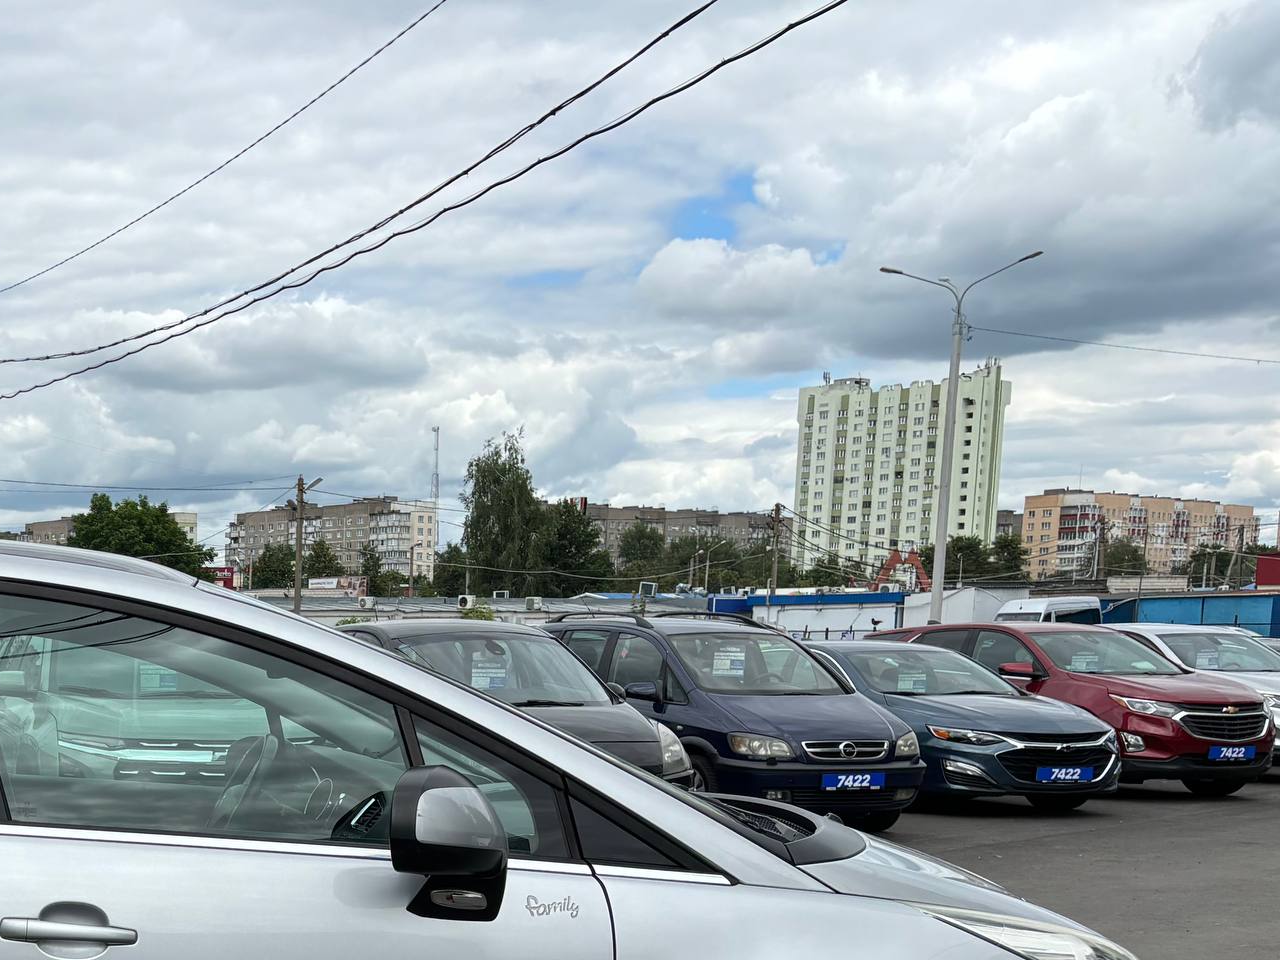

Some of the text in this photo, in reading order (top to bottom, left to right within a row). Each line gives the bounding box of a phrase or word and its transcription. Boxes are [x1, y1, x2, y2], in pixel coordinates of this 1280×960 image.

[1220, 747, 1245, 758] 7422
[1050, 768, 1081, 780] 7422
[836, 774, 871, 788] 7422
[524, 894, 579, 919] family
